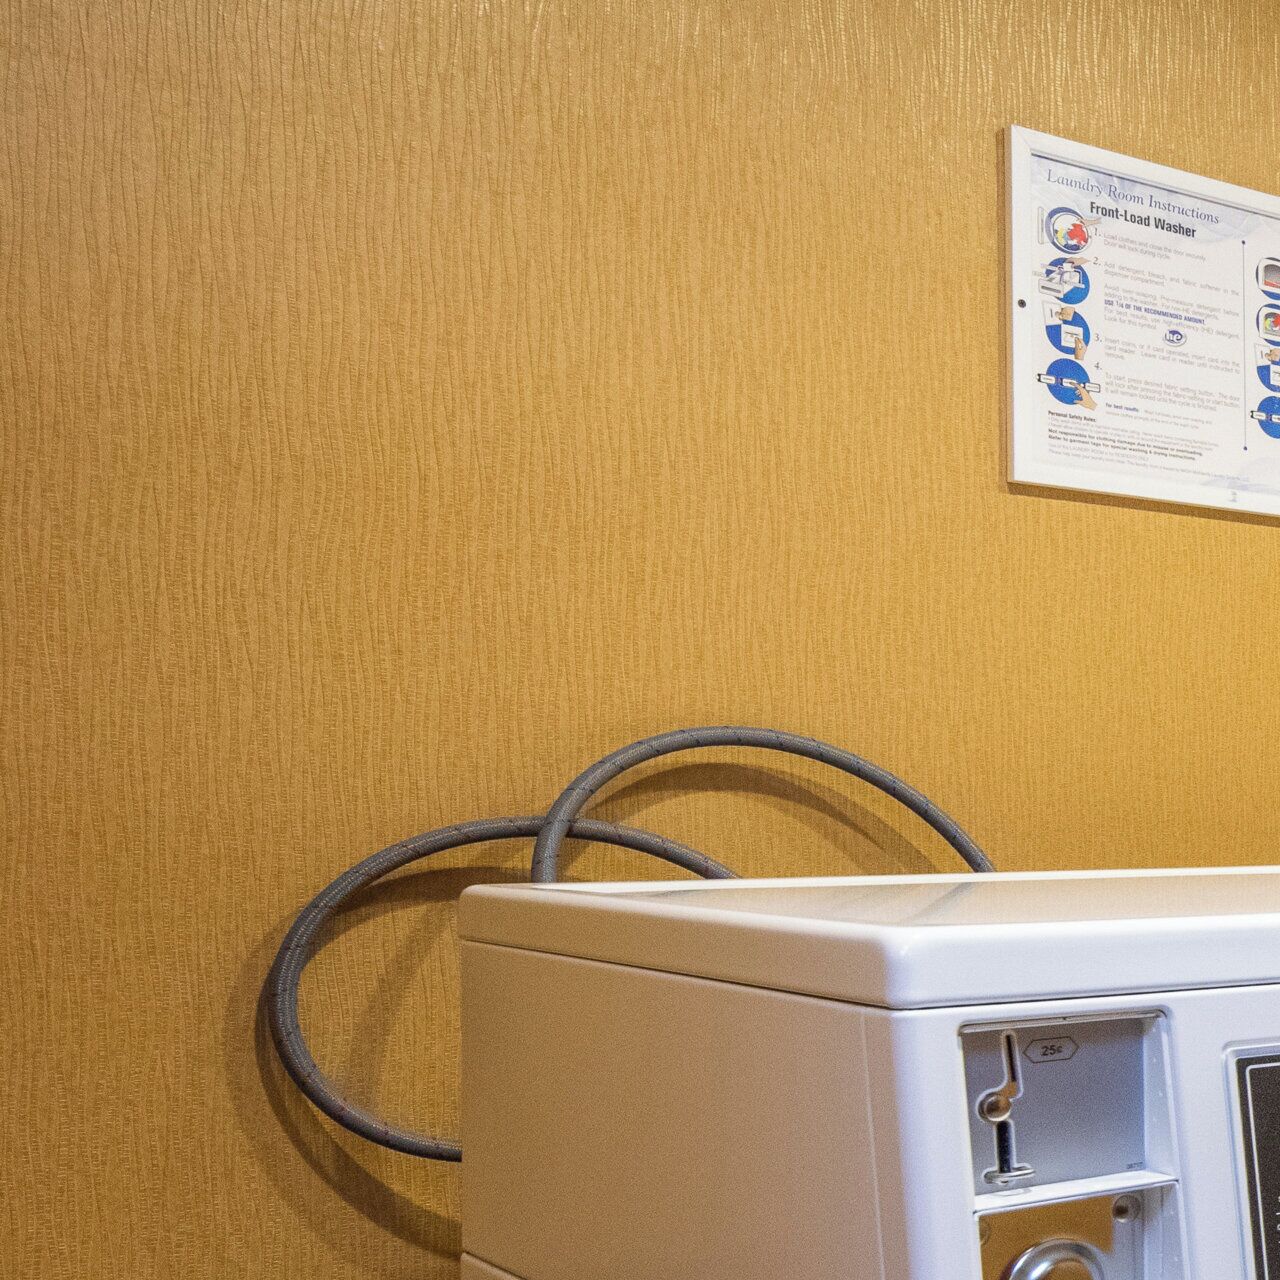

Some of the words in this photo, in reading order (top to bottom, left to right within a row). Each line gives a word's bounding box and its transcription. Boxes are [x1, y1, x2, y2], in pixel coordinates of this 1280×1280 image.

[1047, 168, 1103, 197] Laundry
[1107, 184, 1143, 205] Room
[1148, 194, 1219, 223] Instructions
[1090, 201, 1150, 226] Front-Load
[1154, 217, 1196, 237] Washer
